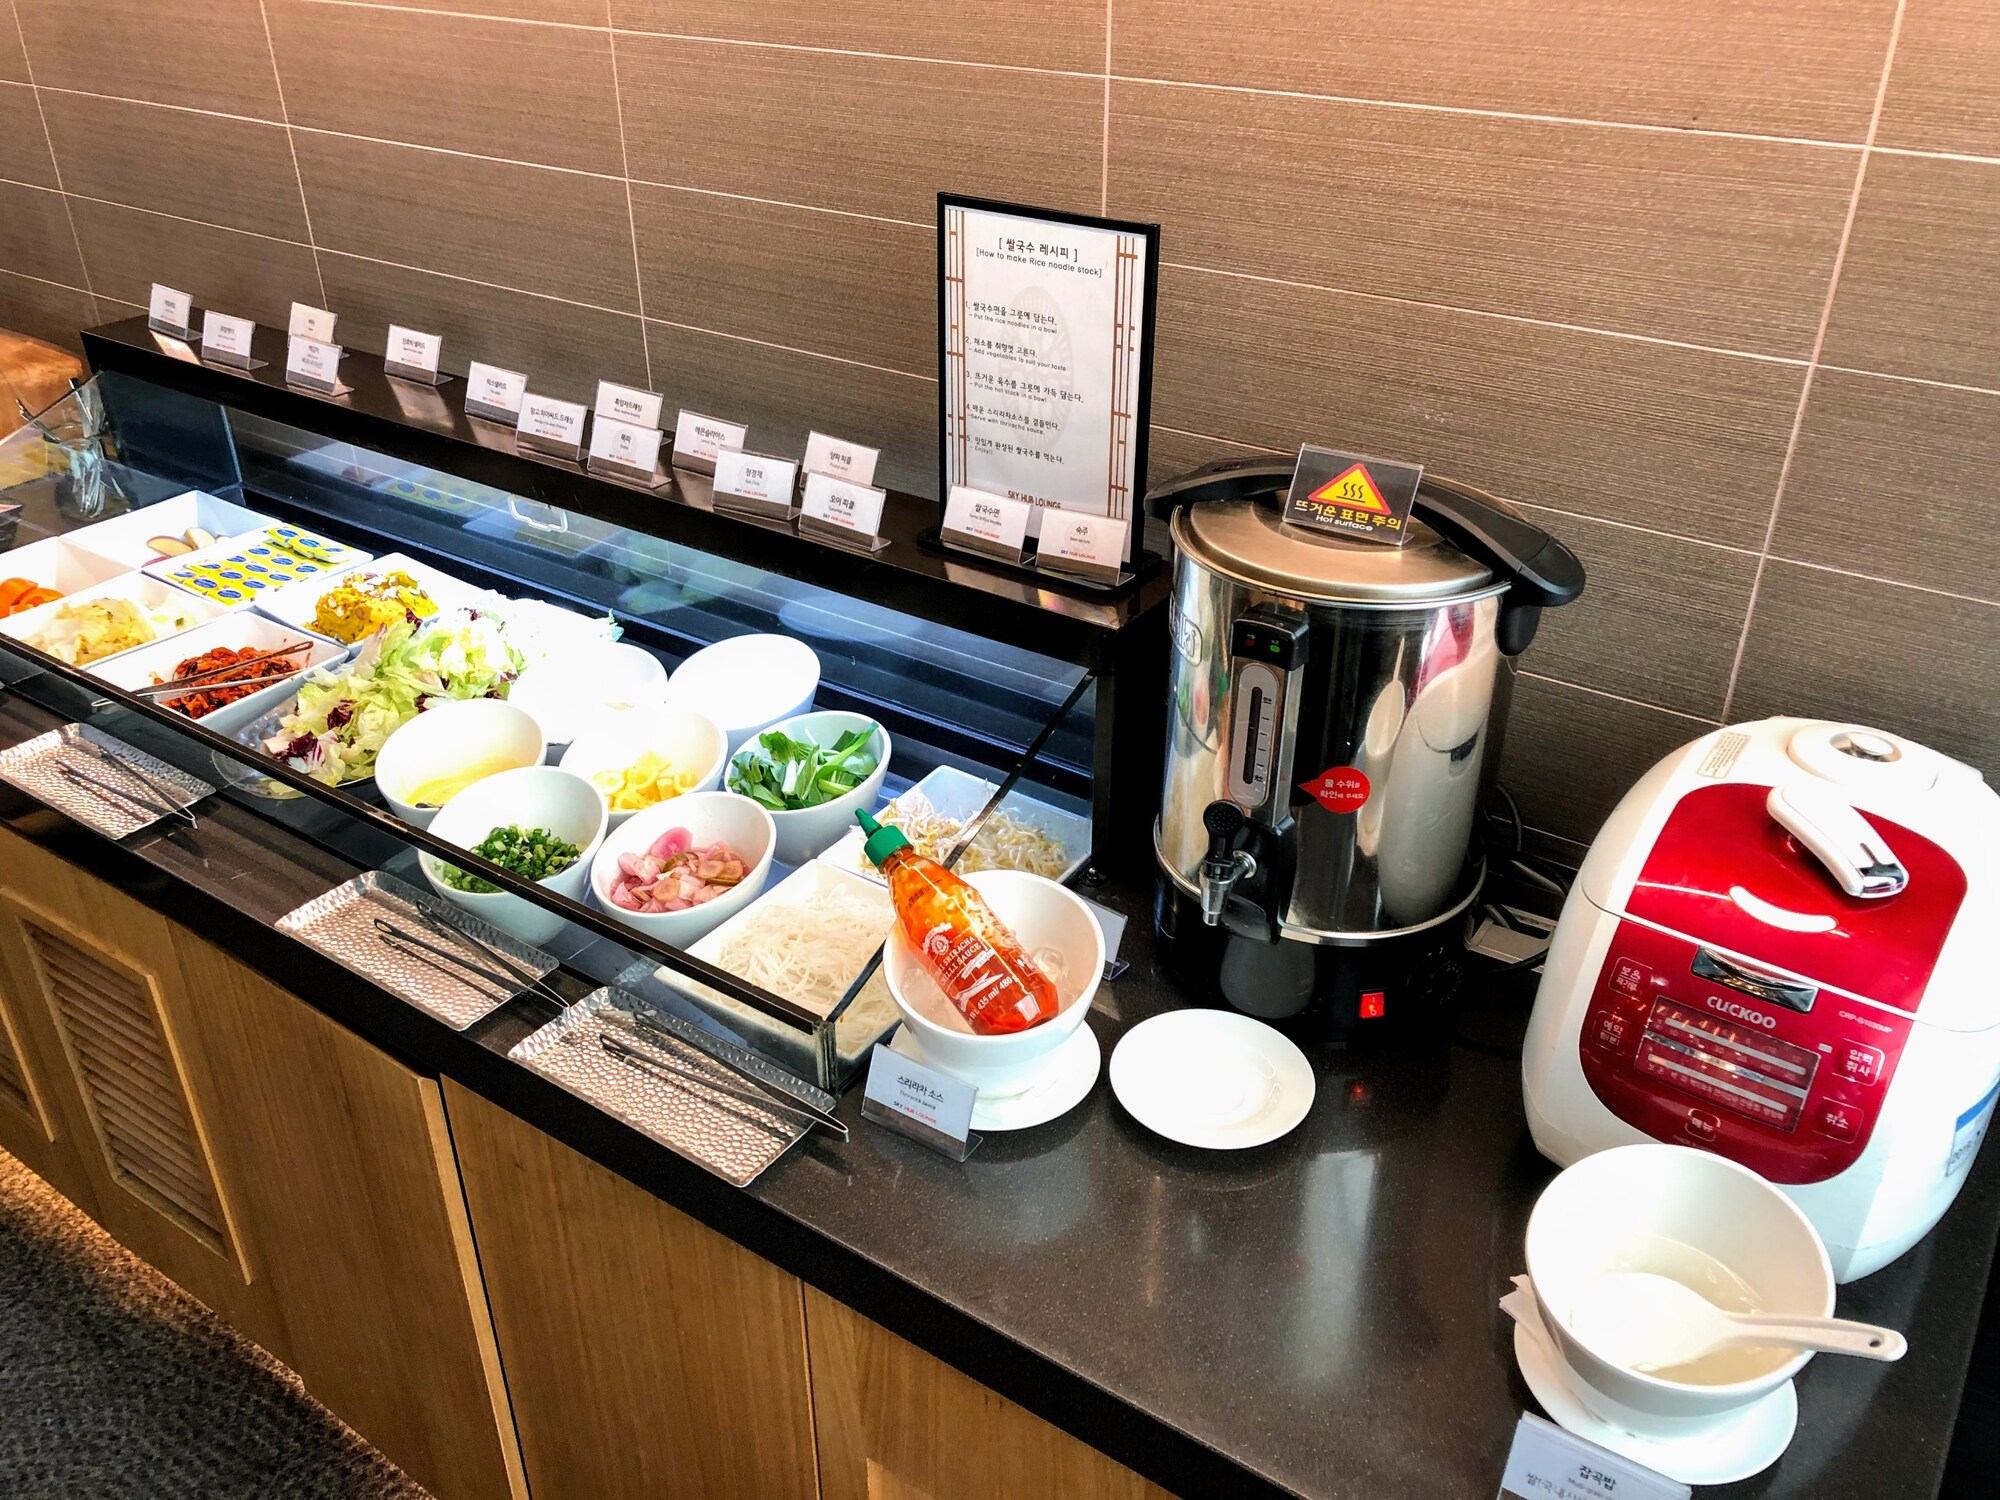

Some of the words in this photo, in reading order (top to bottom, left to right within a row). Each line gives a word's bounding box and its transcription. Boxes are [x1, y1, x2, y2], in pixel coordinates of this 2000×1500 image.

[1006, 238, 1035, 254] 쌀국수
[1040, 244, 1069, 259] 레시피
[976, 248, 994, 258] [How
[1007, 254, 1027, 264] make
[1029, 257, 1046, 267] Rice
[1049, 261, 1075, 272] noodle
[1077, 266, 1102, 278] stock]
[973, 302, 1007, 317] 쌀국수면을
[1009, 309, 1031, 320] 그릇에
[1033, 313, 1057, 326] 담는다.
[1007, 320, 1029, 329] noodles
[974, 338, 993, 349] 채소를
[975, 372, 994, 384] 뜨거운
[997, 376, 1017, 389] 육수를
[1020, 382, 1040, 393] 그릇에
[1043, 387, 1057, 397] 가득
[1060, 390, 1084, 403] 담는다.
[1016, 446, 1041, 460] 쌀국수를
[745, 467, 763, 479] 청경채
[829, 495, 842, 506] 오이
[842, 499, 855, 510] 피클
[1008, 490, 1019, 500] SKY
[1021, 493, 1034, 504] HUB
[1035, 497, 1061, 508] LOUNGE
[975, 503, 1000, 519] 쌀국수면
[1294, 499, 1337, 518] 뜨거운
[1340, 508, 1369, 524] 표면
[1372, 515, 1401, 530] 주의
[1076, 526, 1089, 536] 숙주
[1316, 514, 1333, 524] Hot
[1335, 518, 1374, 532] surface
[943, 936, 975, 966] SRIRACHA
[957, 942, 982, 966] SAUCE
[1620, 966, 1641, 981] 보온
[978, 995, 989, 1010] 435
[1000, 976, 1013, 989] 480
[1706, 995, 1777, 1029] CUCKOO
[1603, 1020, 1623, 1036] 예약
[1849, 1049, 1874, 1065] 압력
[1846, 1060, 1871, 1077] 취사
[897, 1075, 928, 1096] 스리라차
[928, 1090, 944, 1103] 소스
[1825, 1112, 1849, 1129] 취소
[1579, 1464, 1616, 1491] 잡곡밥
